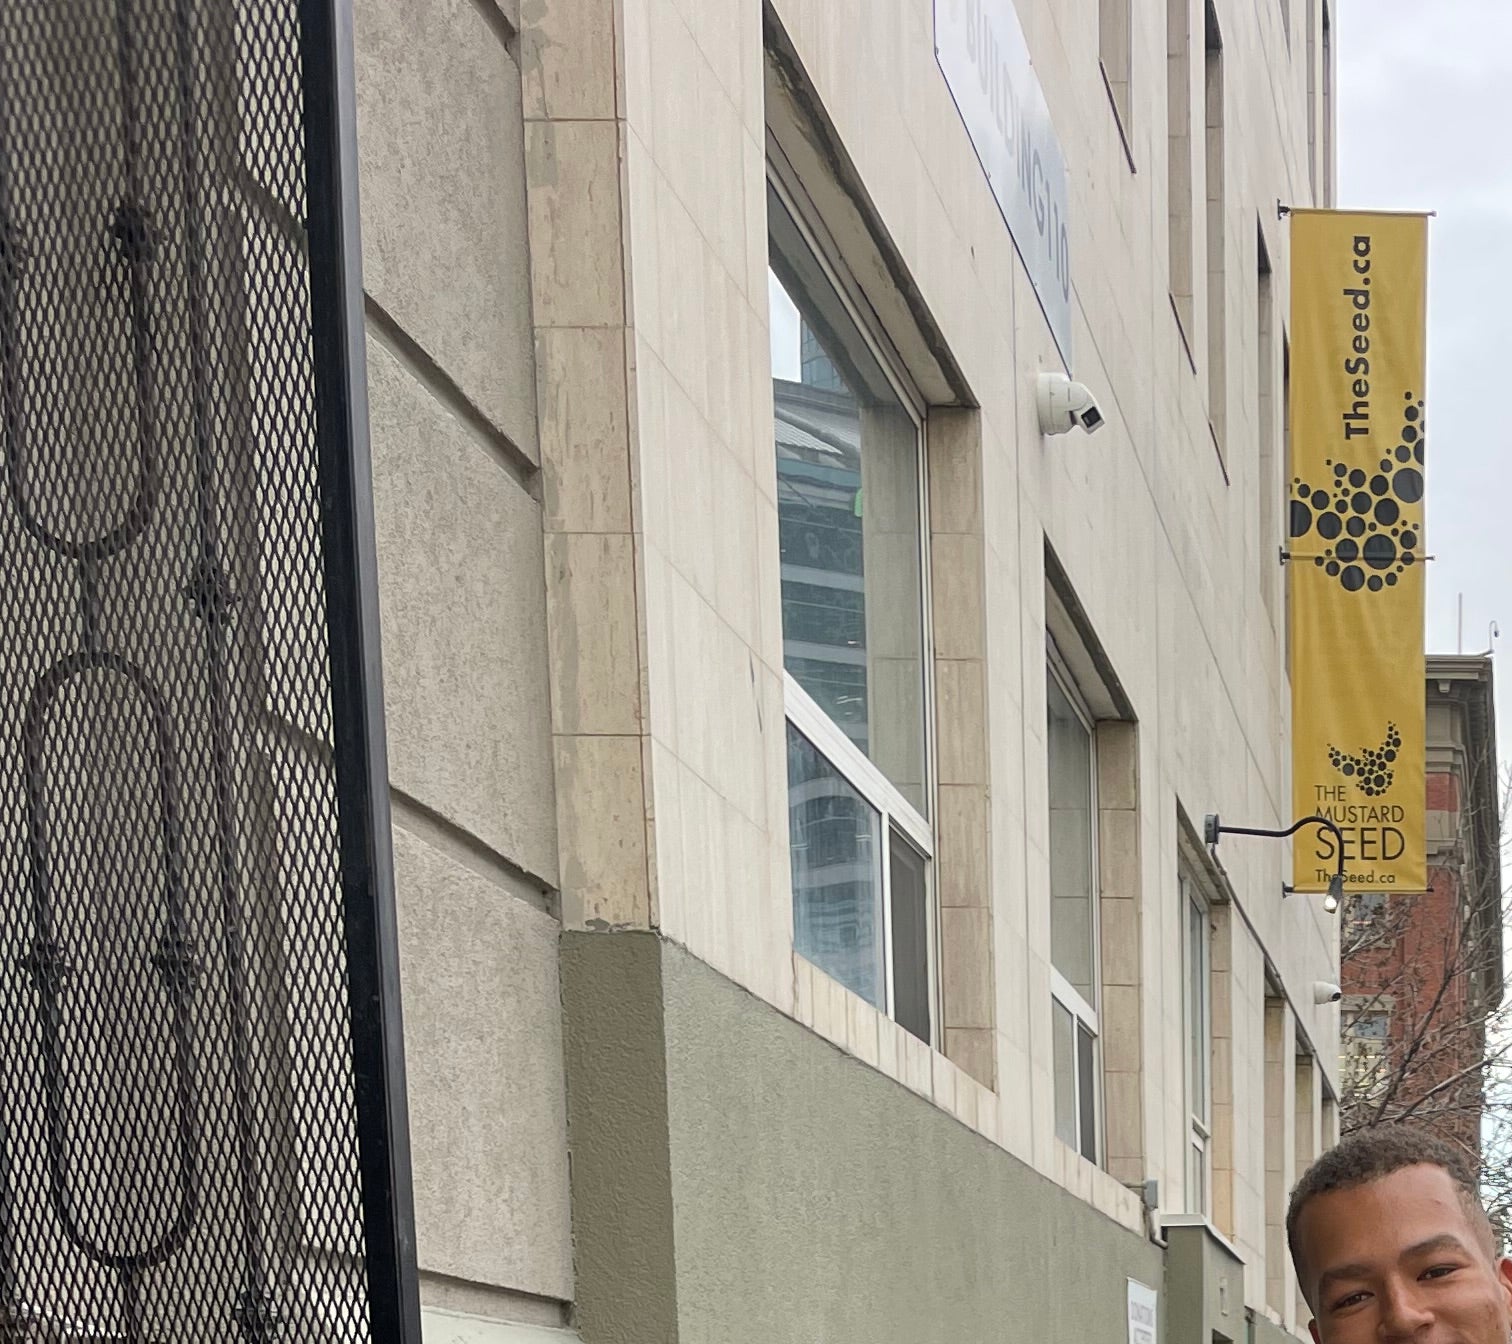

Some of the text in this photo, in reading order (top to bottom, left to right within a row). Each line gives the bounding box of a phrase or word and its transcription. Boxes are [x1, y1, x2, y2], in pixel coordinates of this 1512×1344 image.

[1343, 235, 1371, 440] TheSeed.ca
[1314, 784, 1346, 802] THE
[1316, 805, 1405, 823] MUSTARD
[1315, 826, 1405, 861] SEED
[1315, 867, 1396, 883] ThSeed.ca
